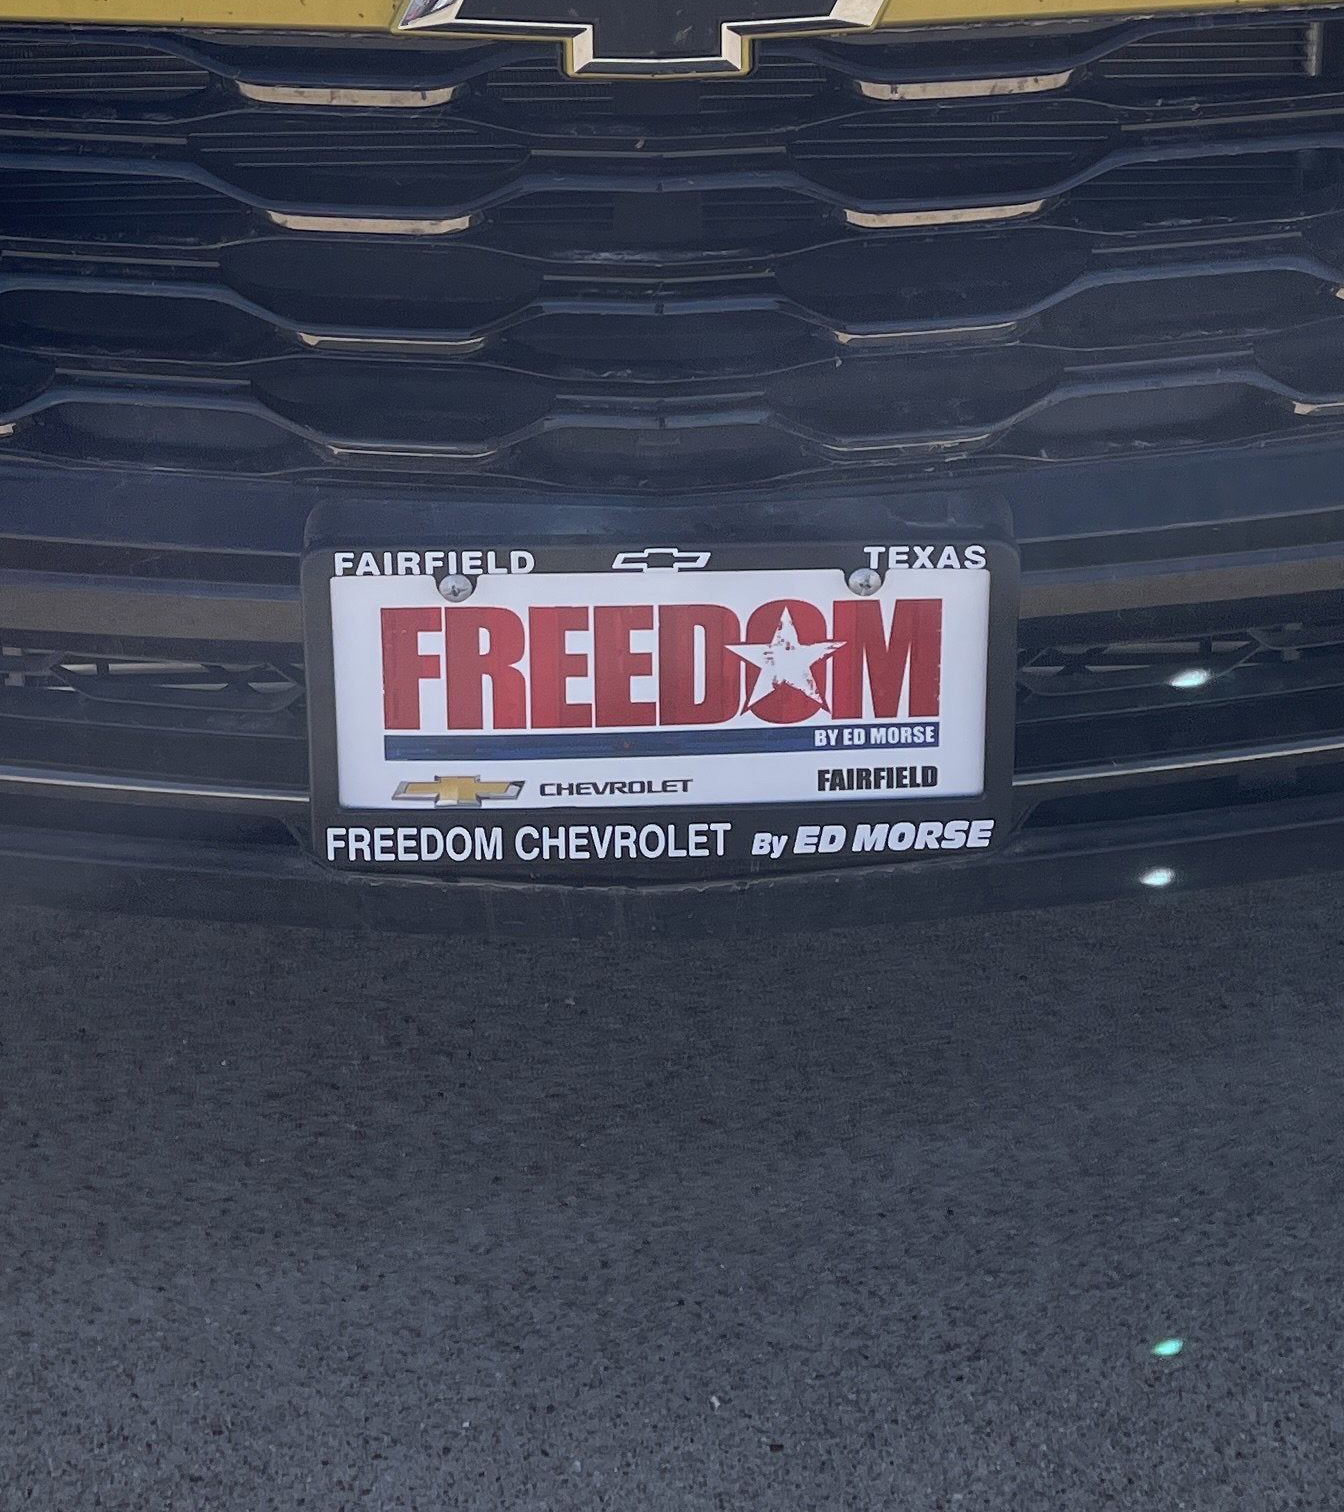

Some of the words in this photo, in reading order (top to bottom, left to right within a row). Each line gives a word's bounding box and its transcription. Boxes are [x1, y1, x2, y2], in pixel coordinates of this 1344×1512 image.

[334, 551, 535, 576] FAIRFIELD
[863, 545, 987, 570] TEXAS
[380, 599, 942, 730] FREEDOM
[814, 729, 838, 747] BY
[844, 727, 865, 745] ED
[870, 726, 935, 744] MORSE
[539, 778, 694, 797] CHEVROLET
[817, 765, 938, 792] FAIRFIELD
[326, 826, 503, 861] FREEDOM
[514, 822, 732, 861] CHEVROLET
[751, 832, 788, 859] By
[793, 825, 846, 854] ED
[851, 819, 995, 852] MORSE
